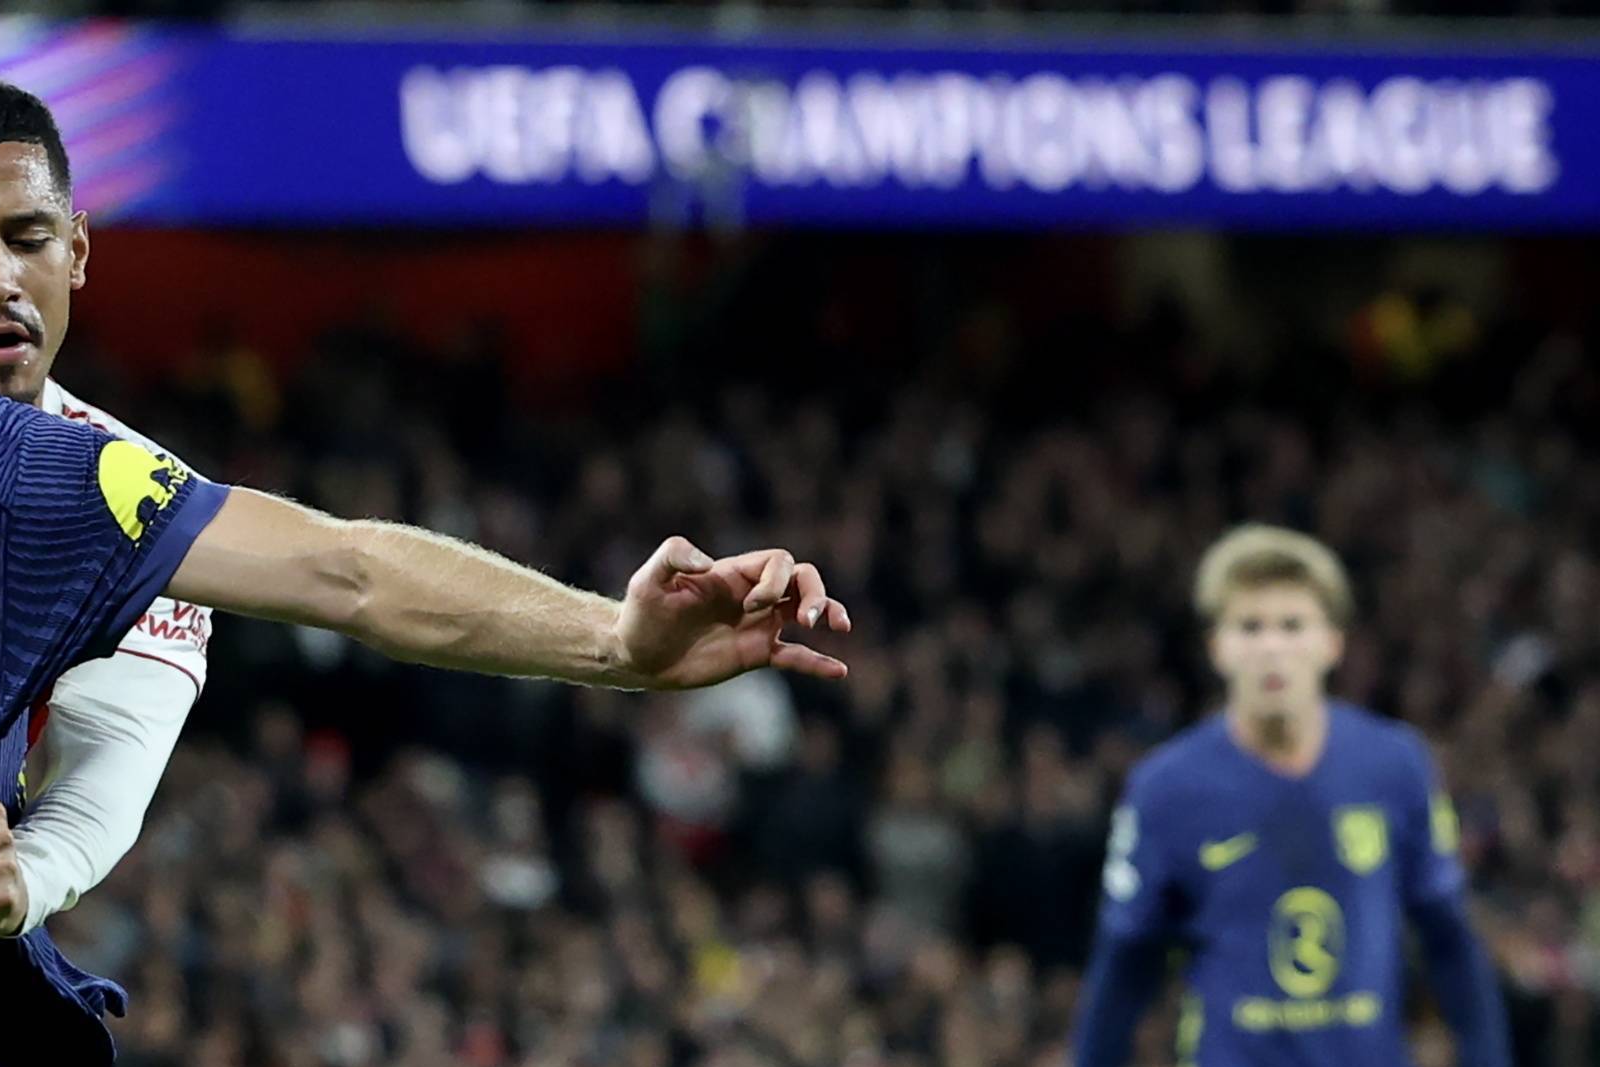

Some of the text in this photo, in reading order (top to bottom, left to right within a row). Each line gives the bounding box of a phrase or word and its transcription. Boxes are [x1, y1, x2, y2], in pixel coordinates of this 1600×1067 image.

[402, 66, 1557, 194] UEFA CHAMPIONS LEAGUE
